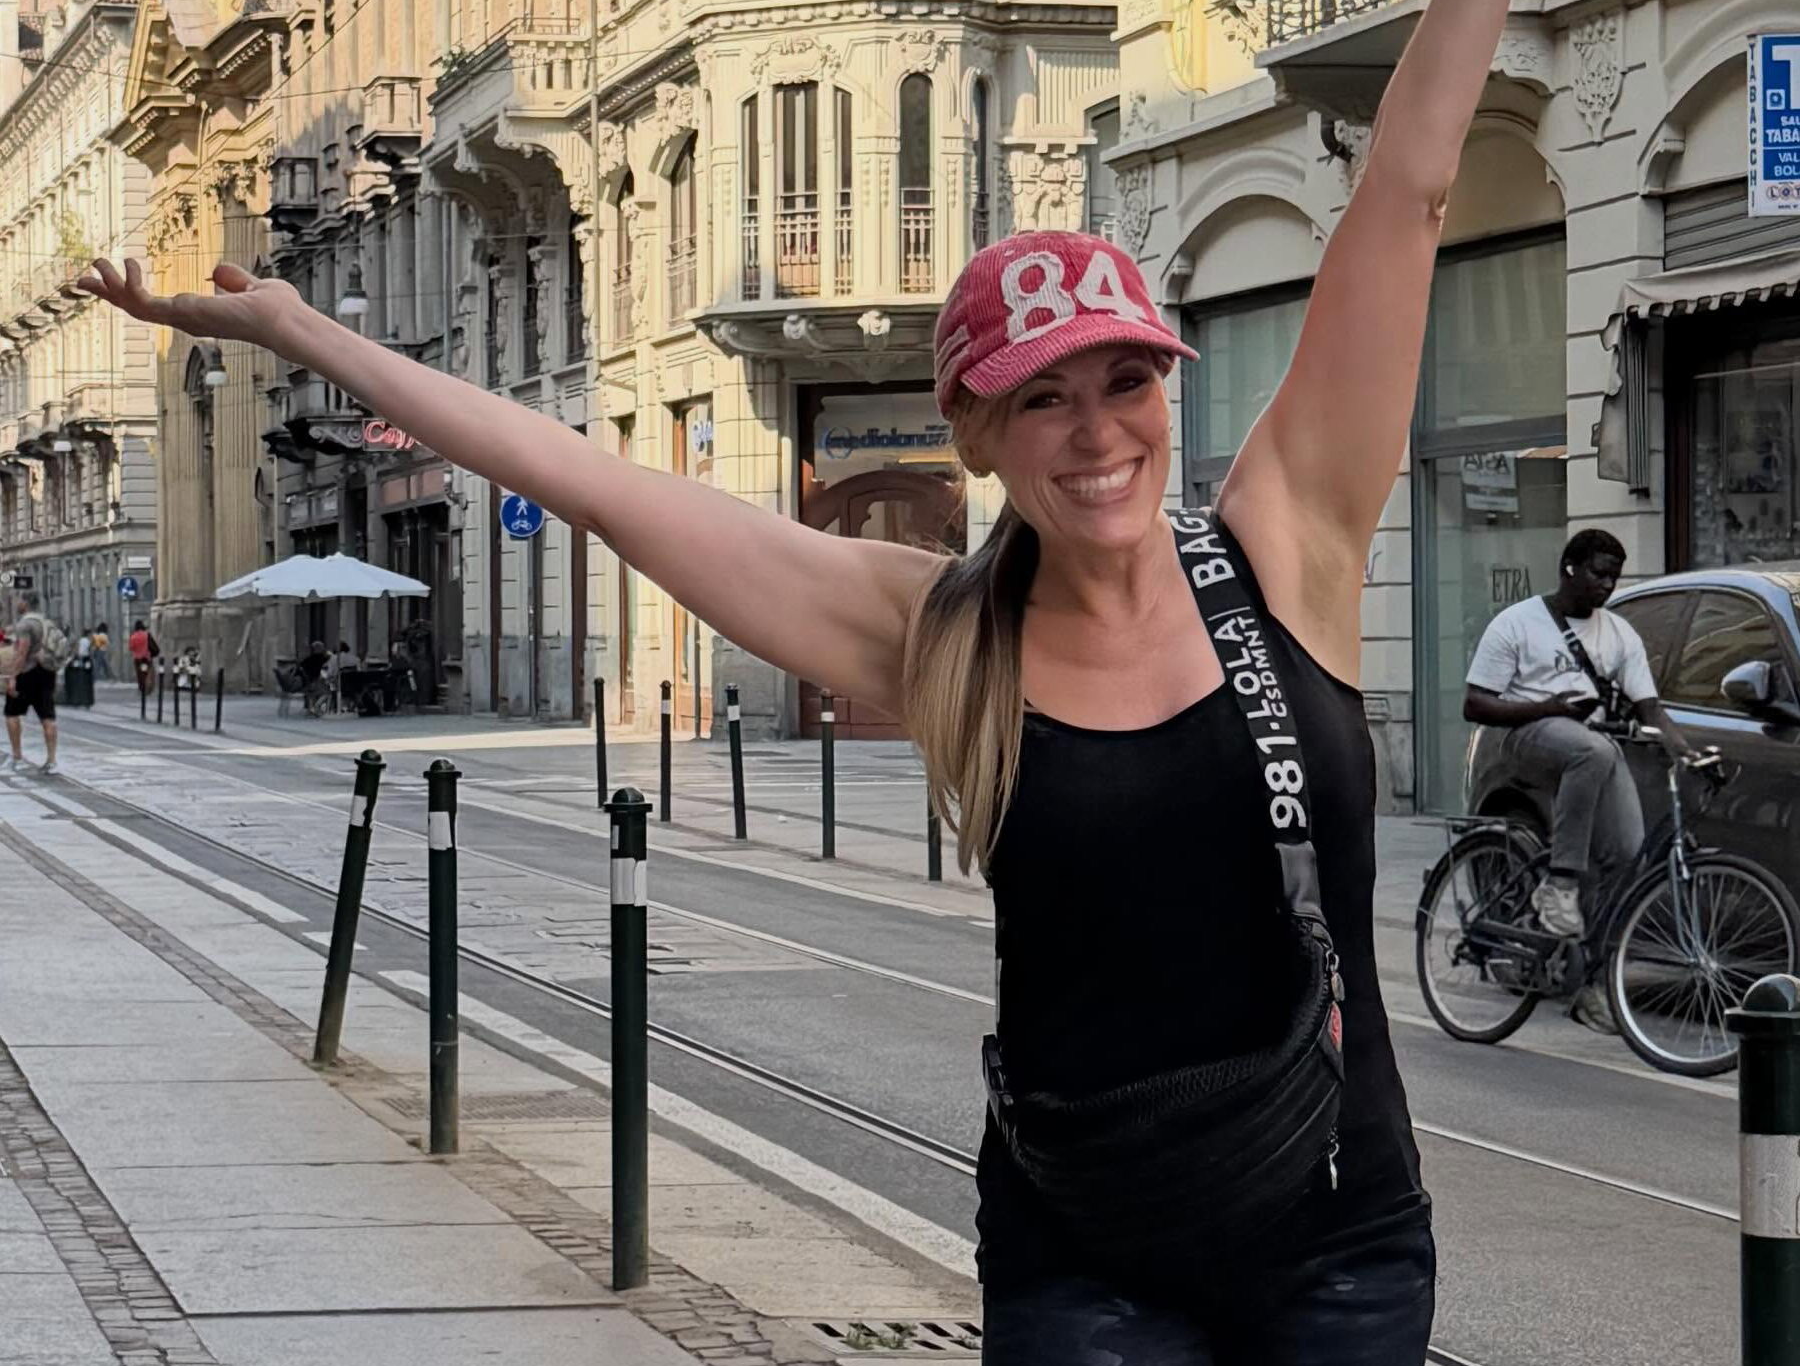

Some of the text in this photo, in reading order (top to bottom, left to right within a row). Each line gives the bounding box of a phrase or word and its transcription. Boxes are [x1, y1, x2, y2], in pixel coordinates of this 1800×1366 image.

[1749, 43, 1757, 208] TABACCHI
[1001, 251, 1147, 343] 84
[1492, 568, 1531, 603] ETRA
[1214, 617, 1272, 720] LOLA
[1238, 615, 1288, 718] CSDMNT
